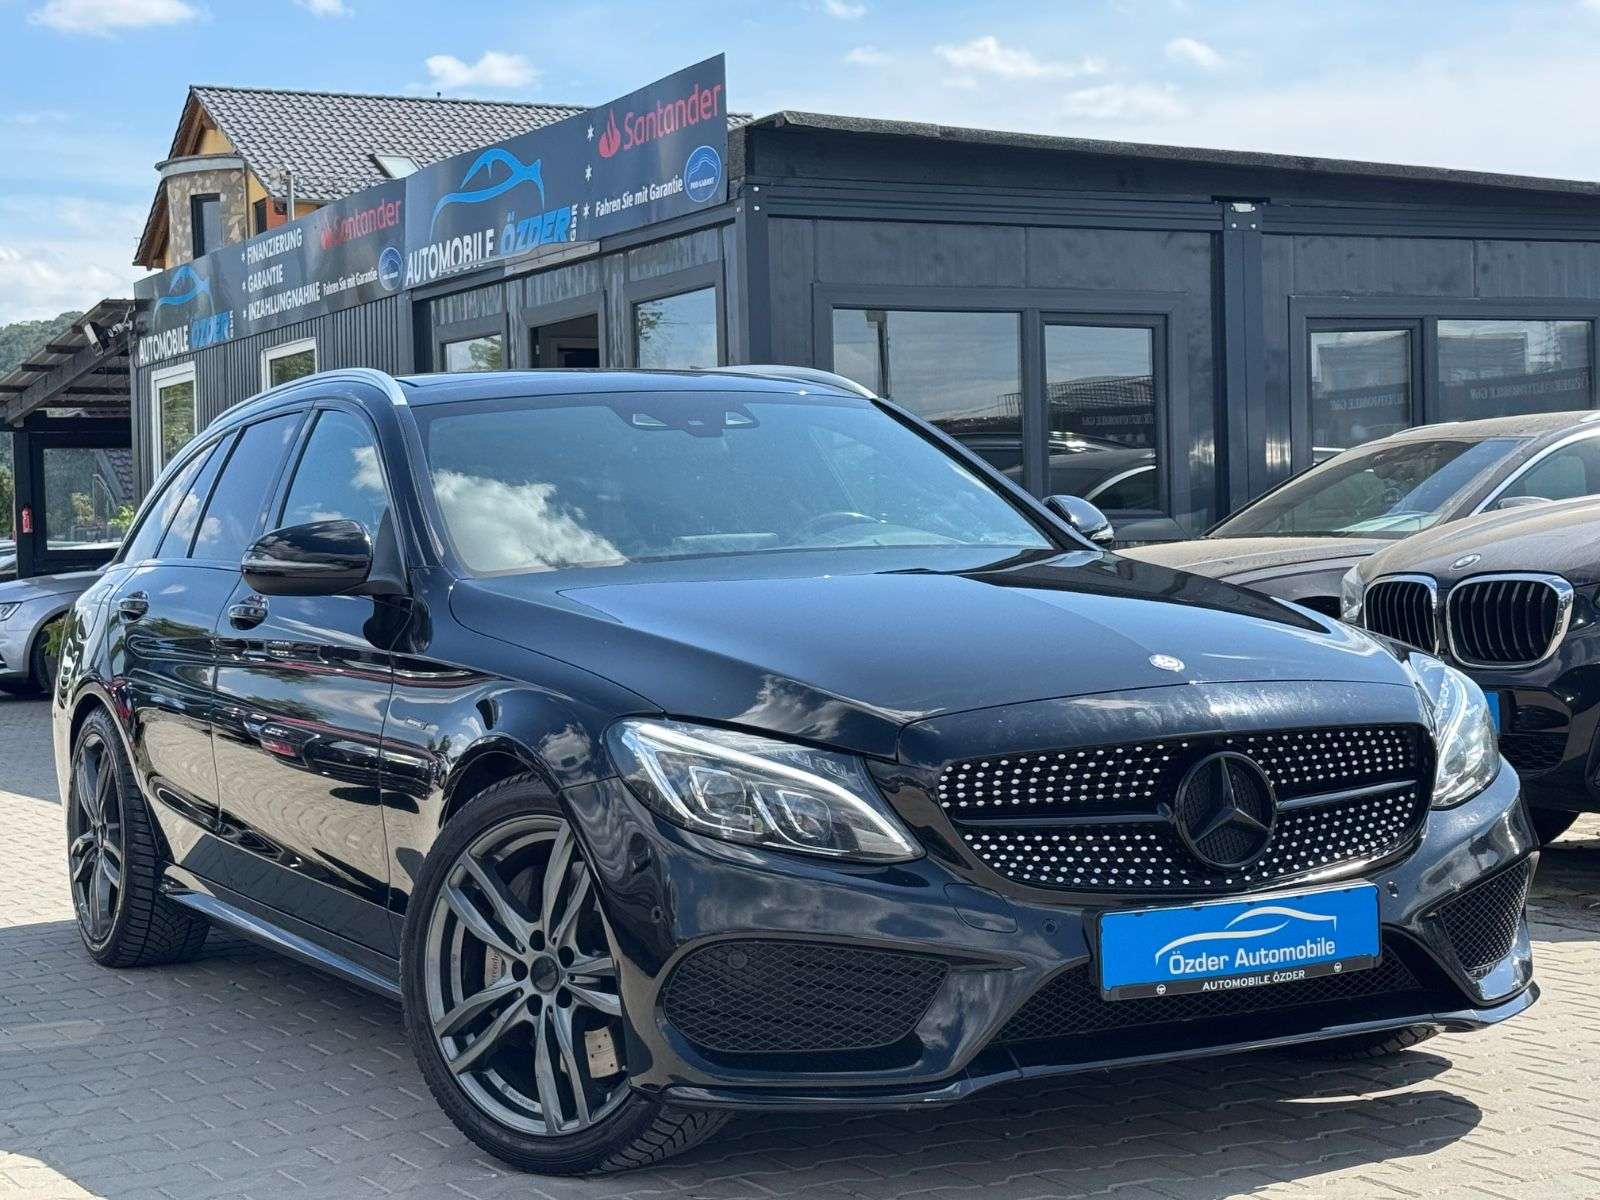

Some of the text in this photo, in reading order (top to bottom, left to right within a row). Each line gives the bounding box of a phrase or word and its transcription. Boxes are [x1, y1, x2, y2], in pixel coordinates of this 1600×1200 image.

[623, 83, 722, 151] Santander
[595, 175, 684, 218] Fahren Sie mit Garantie
[247, 228, 303, 265] FINANZIERUNG
[405, 228, 495, 286] AUTOMOBILE
[501, 206, 571, 255] ÖZDER
[247, 264, 283, 293] GARANTIE
[248, 281, 321, 320] INZAHLUNGNAHME
[139, 324, 189, 364] AUTOMOBILE
[1169, 937, 1336, 975] Özder Automobile
[1202, 969, 1305, 991] AUTOMOBILE ÖZDER
